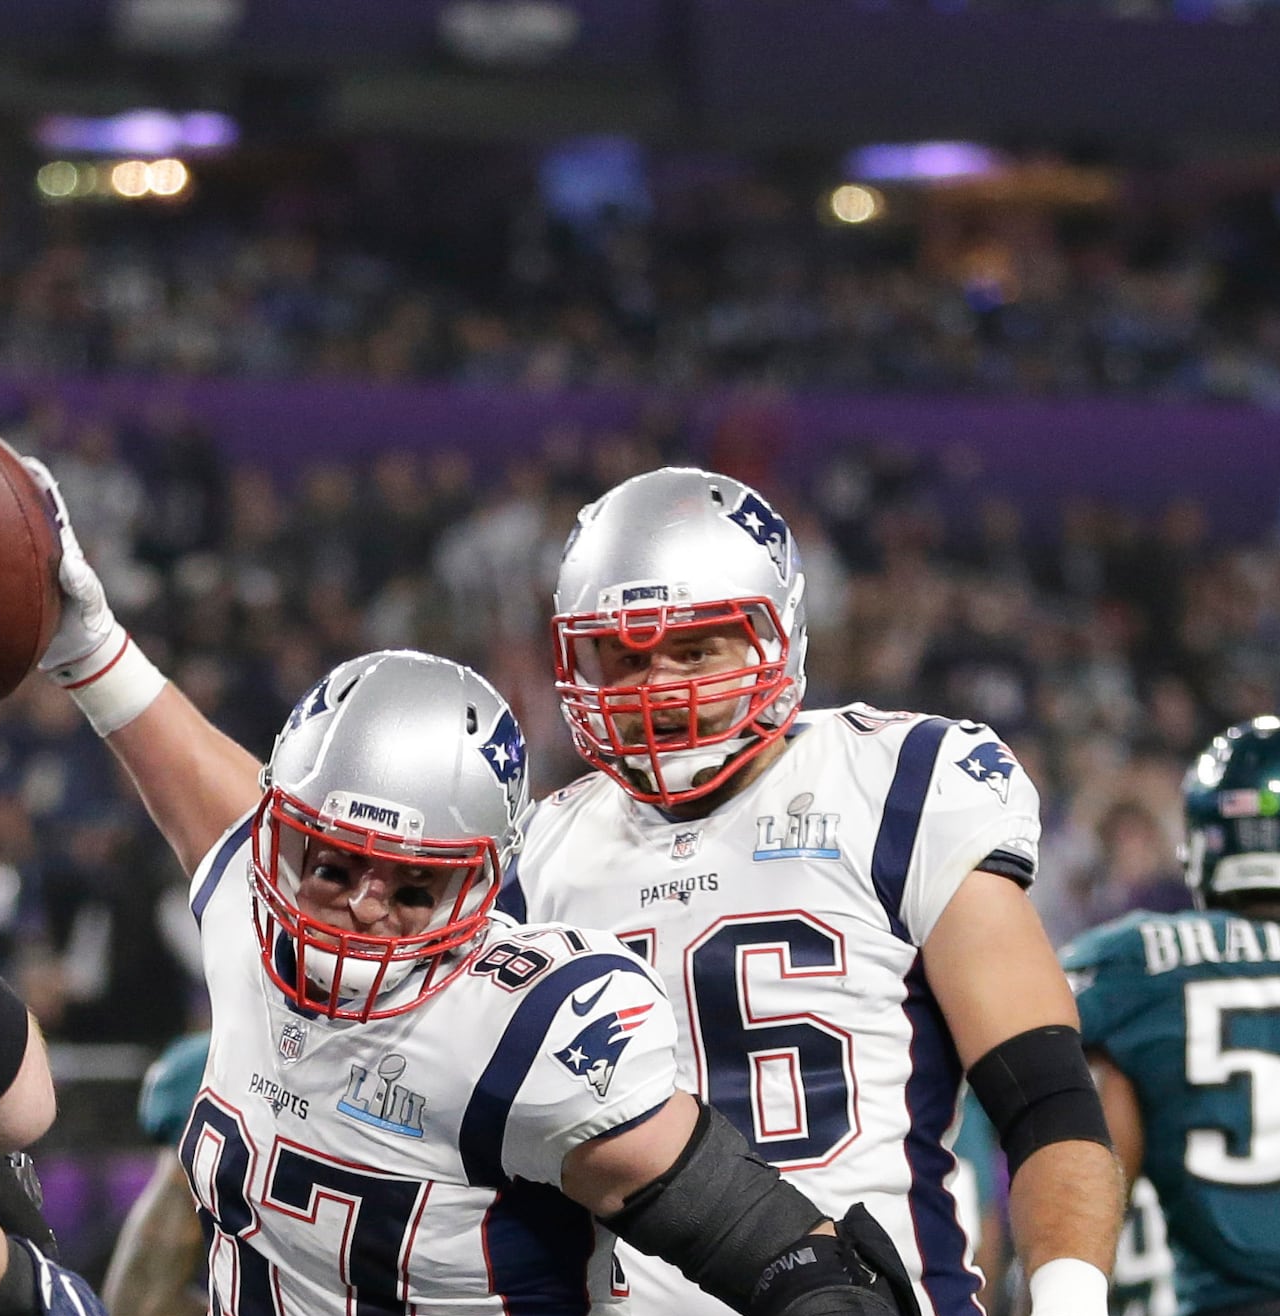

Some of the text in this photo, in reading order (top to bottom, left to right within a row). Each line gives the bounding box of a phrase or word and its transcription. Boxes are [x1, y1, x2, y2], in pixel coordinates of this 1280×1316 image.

[348, 800, 400, 830] PATRIOTS
[640, 873, 719, 908] PATRIOTS
[614, 908, 861, 1173] 6
[249, 1073, 310, 1121] PATRIOTS
